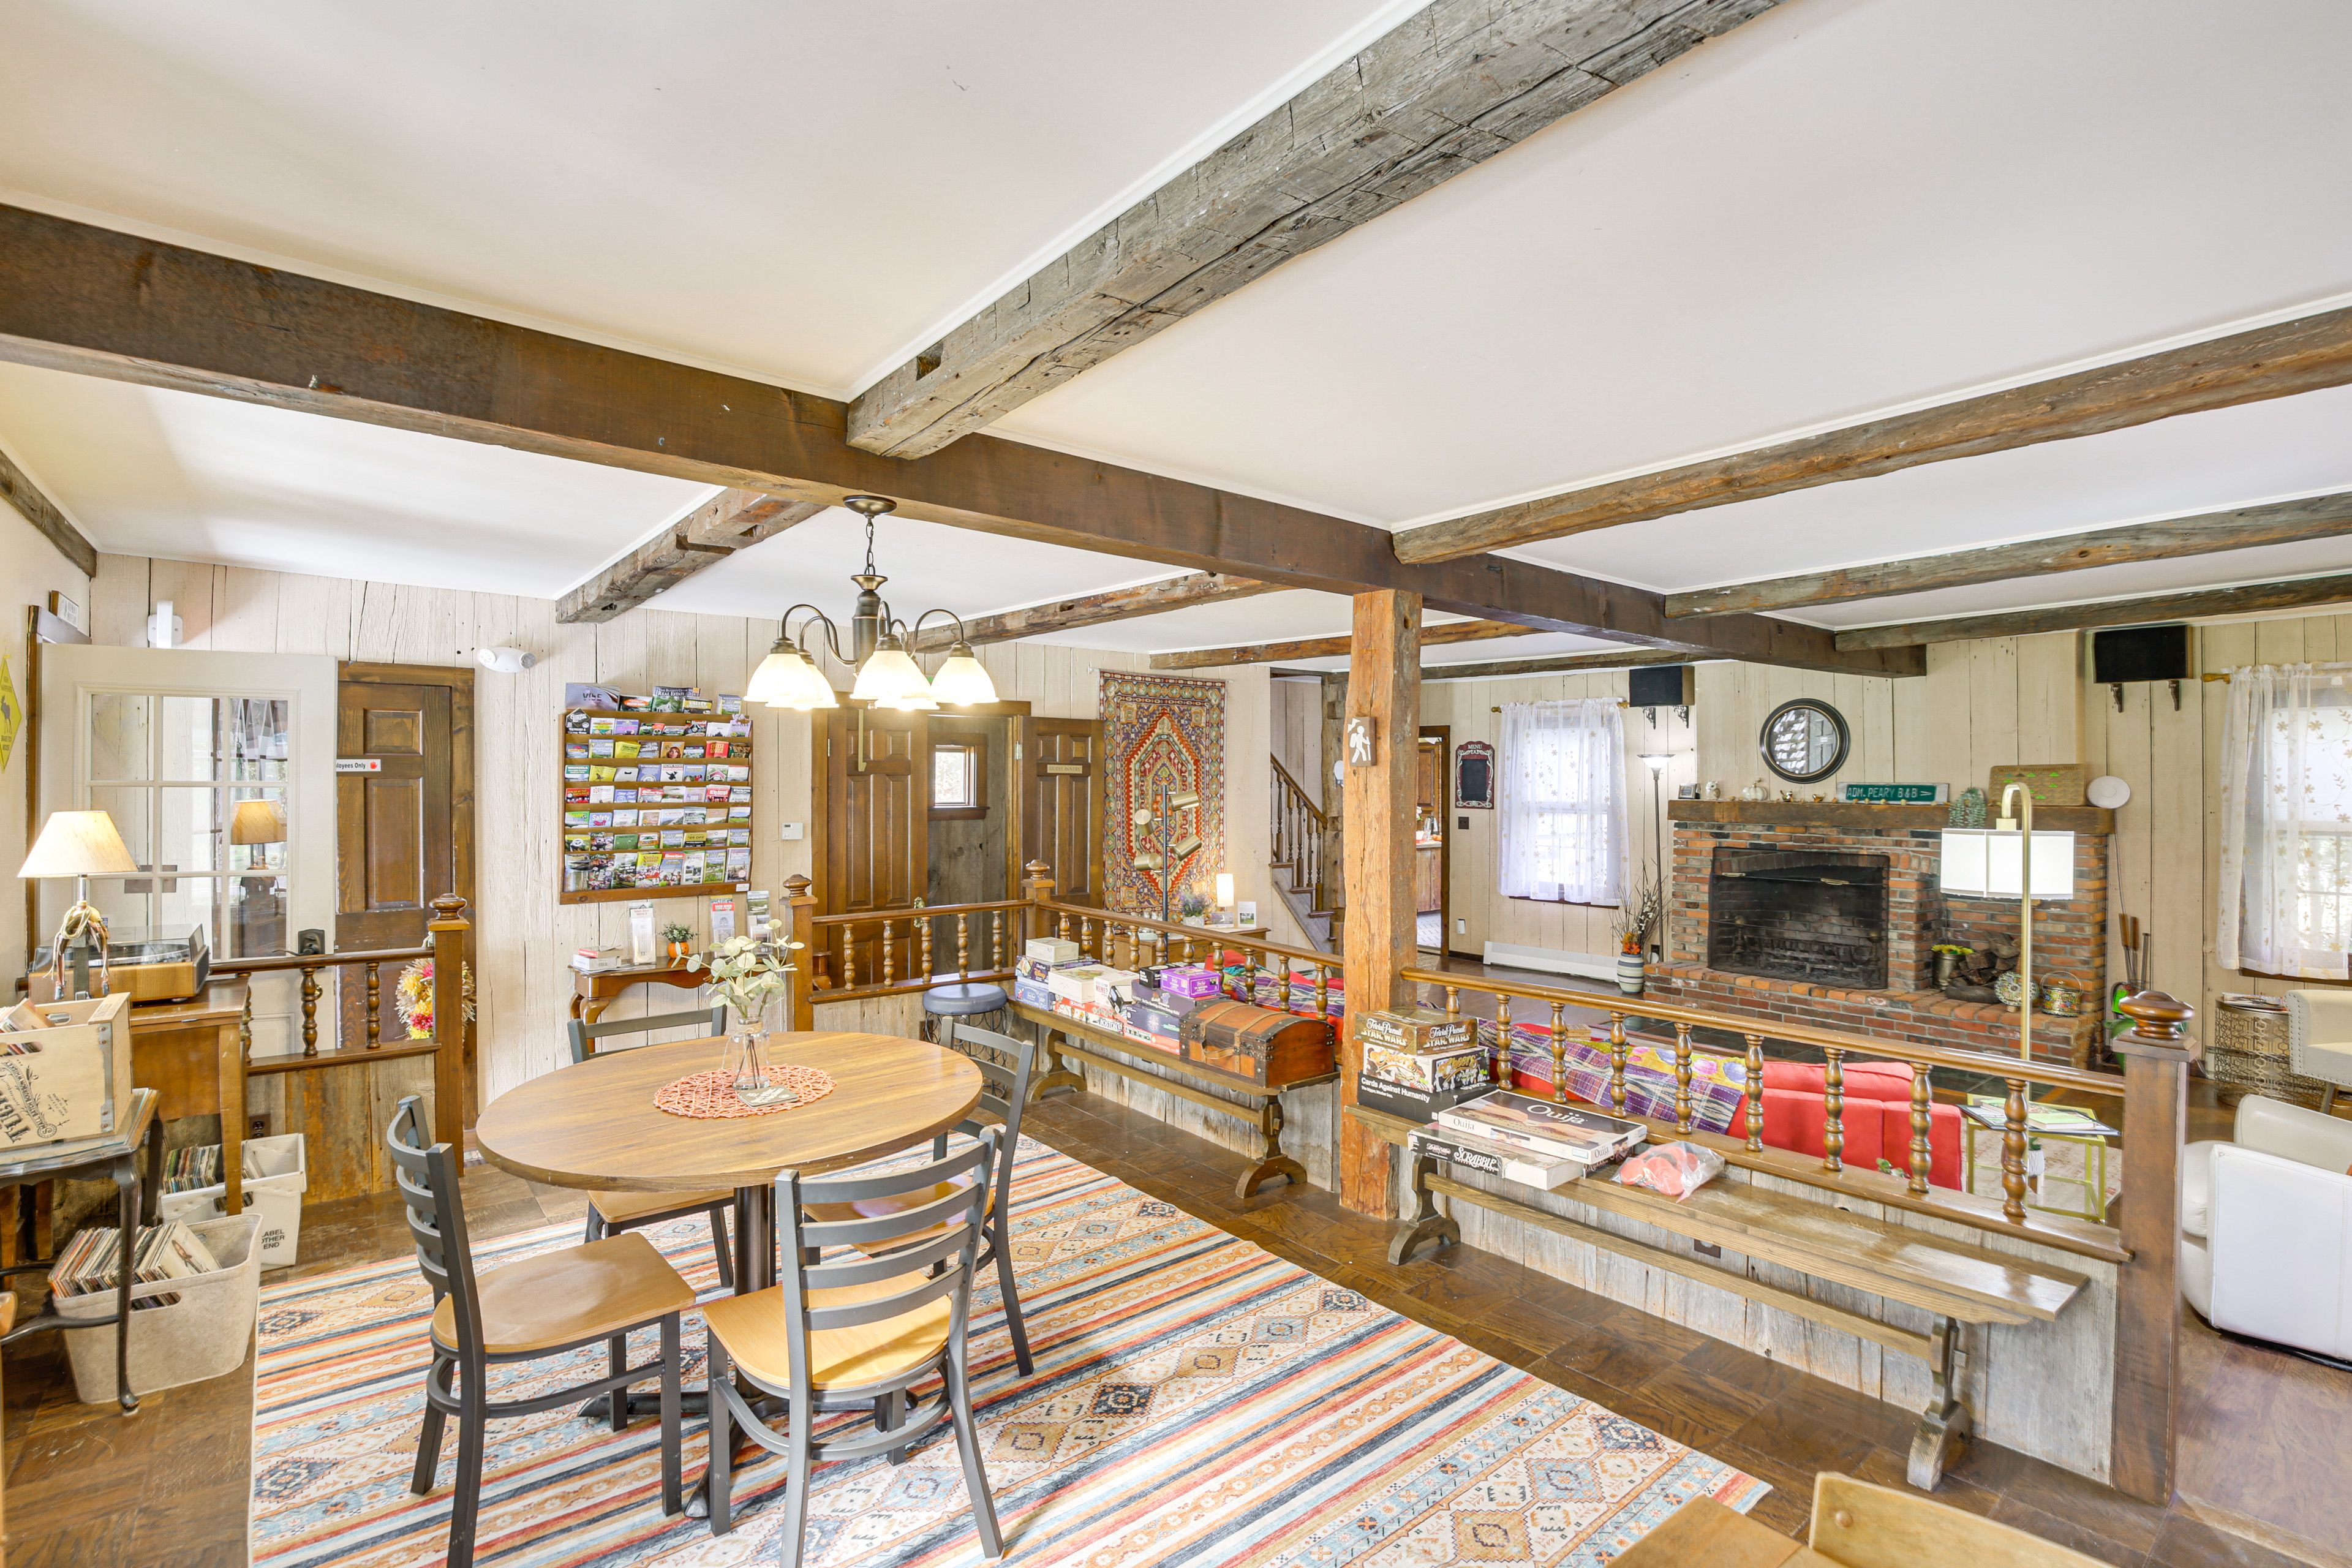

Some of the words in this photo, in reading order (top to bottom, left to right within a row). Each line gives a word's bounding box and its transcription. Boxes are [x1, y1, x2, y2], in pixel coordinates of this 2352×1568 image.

[1847, 787, 1866, 797] ADM.
[1868, 788, 1895, 797] PEARY
[1898, 788, 1917, 798] B&B
[1096, 985, 1108, 993] MEME?
[1366, 1018, 1384, 1030] Trivial
[1382, 1021, 1403, 1035] Pursuit
[1429, 1027, 1447, 1039] Trivial
[1446, 1023, 1466, 1038] Pursuit
[1361, 1028, 1383, 1040] STAR
[1384, 1034, 1408, 1046] WARS
[1423, 1038, 1447, 1048] STAR
[1448, 1033, 1471, 1044] WARS
[6, 1060, 23, 1080] WHISKEY
[1438, 1055, 1477, 1077] Cheers
[18, 1080, 31, 1102] BOURBON
[1361, 1077, 1378, 1087] Cards
[1379, 1082, 1401, 1095] Against
[1401, 1088, 1431, 1103] Humanity
[27, 1102, 38, 1117] BATCH
[1526, 1104, 1585, 1125] Ouija
[34, 1116, 51, 1135] SMALL
[1453, 1117, 1475, 1131] Ouija
[1453, 1147, 1499, 1170] SCRABBLE
[1594, 1145, 1610, 1159] Ouija
